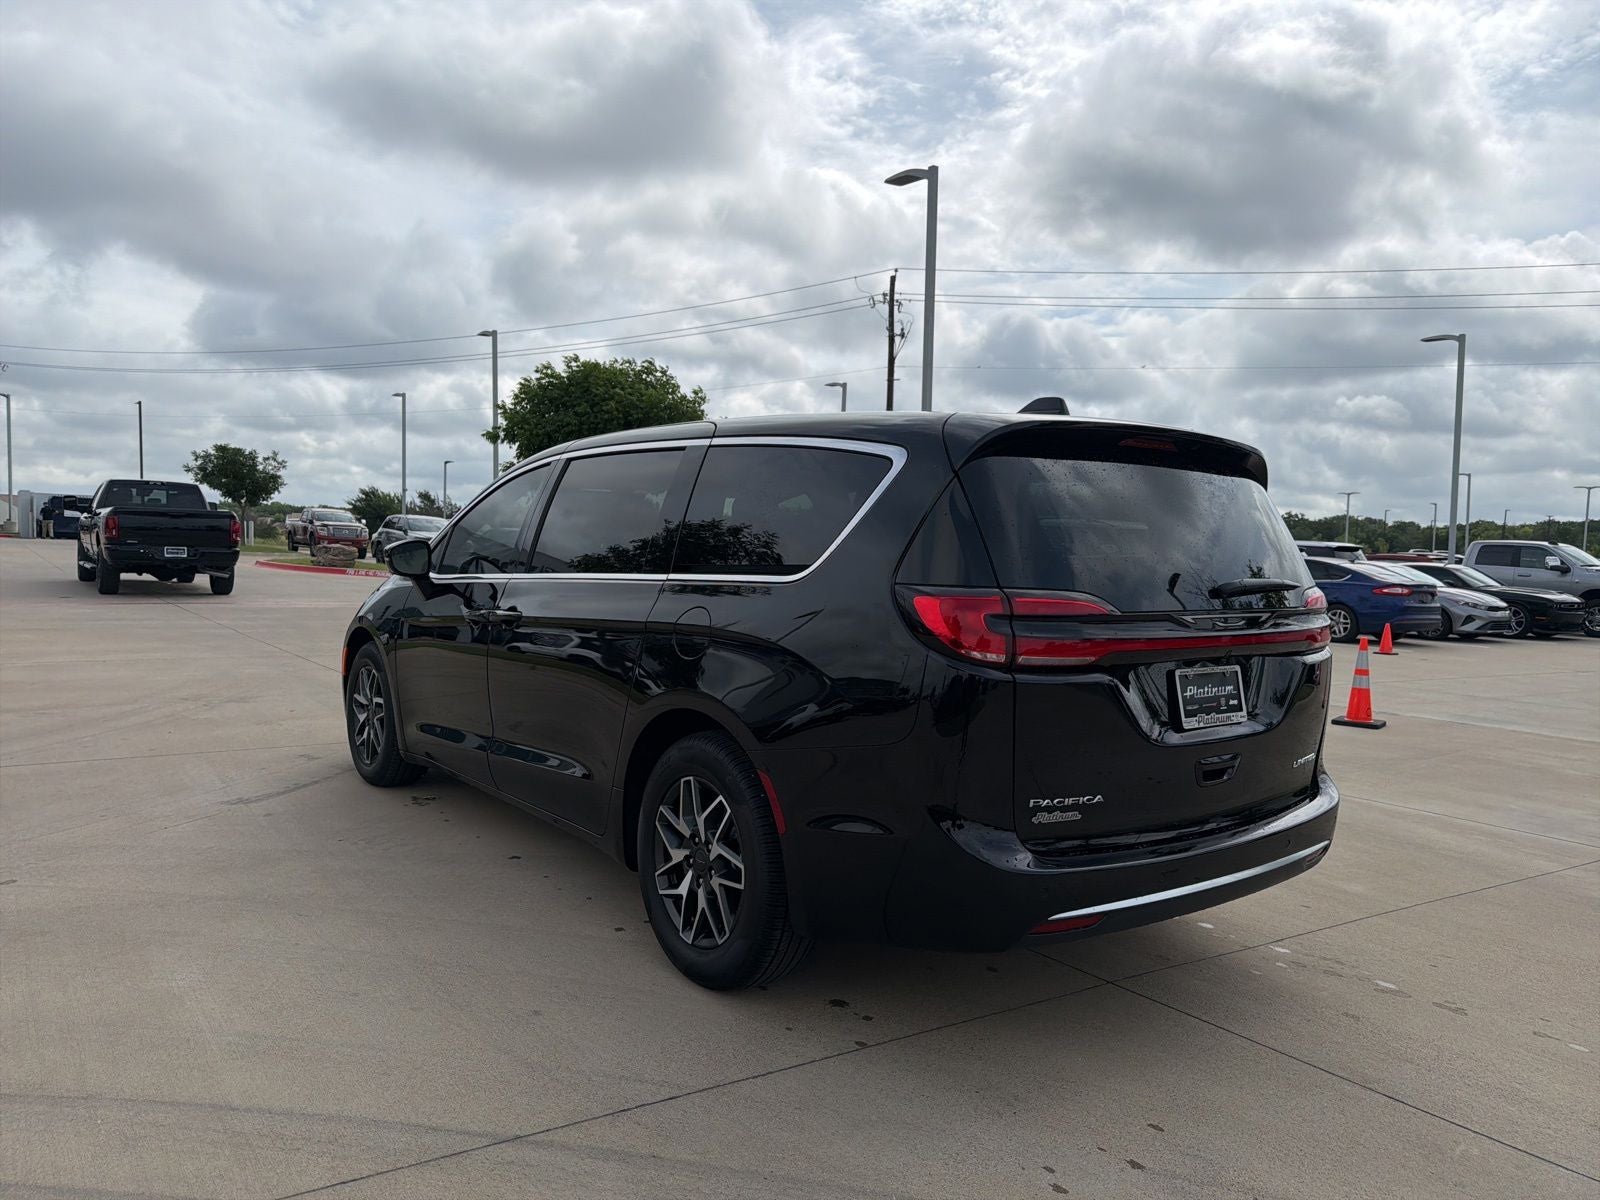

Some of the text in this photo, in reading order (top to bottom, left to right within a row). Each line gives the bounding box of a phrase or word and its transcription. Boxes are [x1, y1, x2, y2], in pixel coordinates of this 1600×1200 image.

[1183, 684, 1238, 699] Platinum
[1197, 714, 1234, 726] Platinum
[1029, 794, 1105, 808] PACIFICA
[1031, 811, 1082, 824] Platinum
